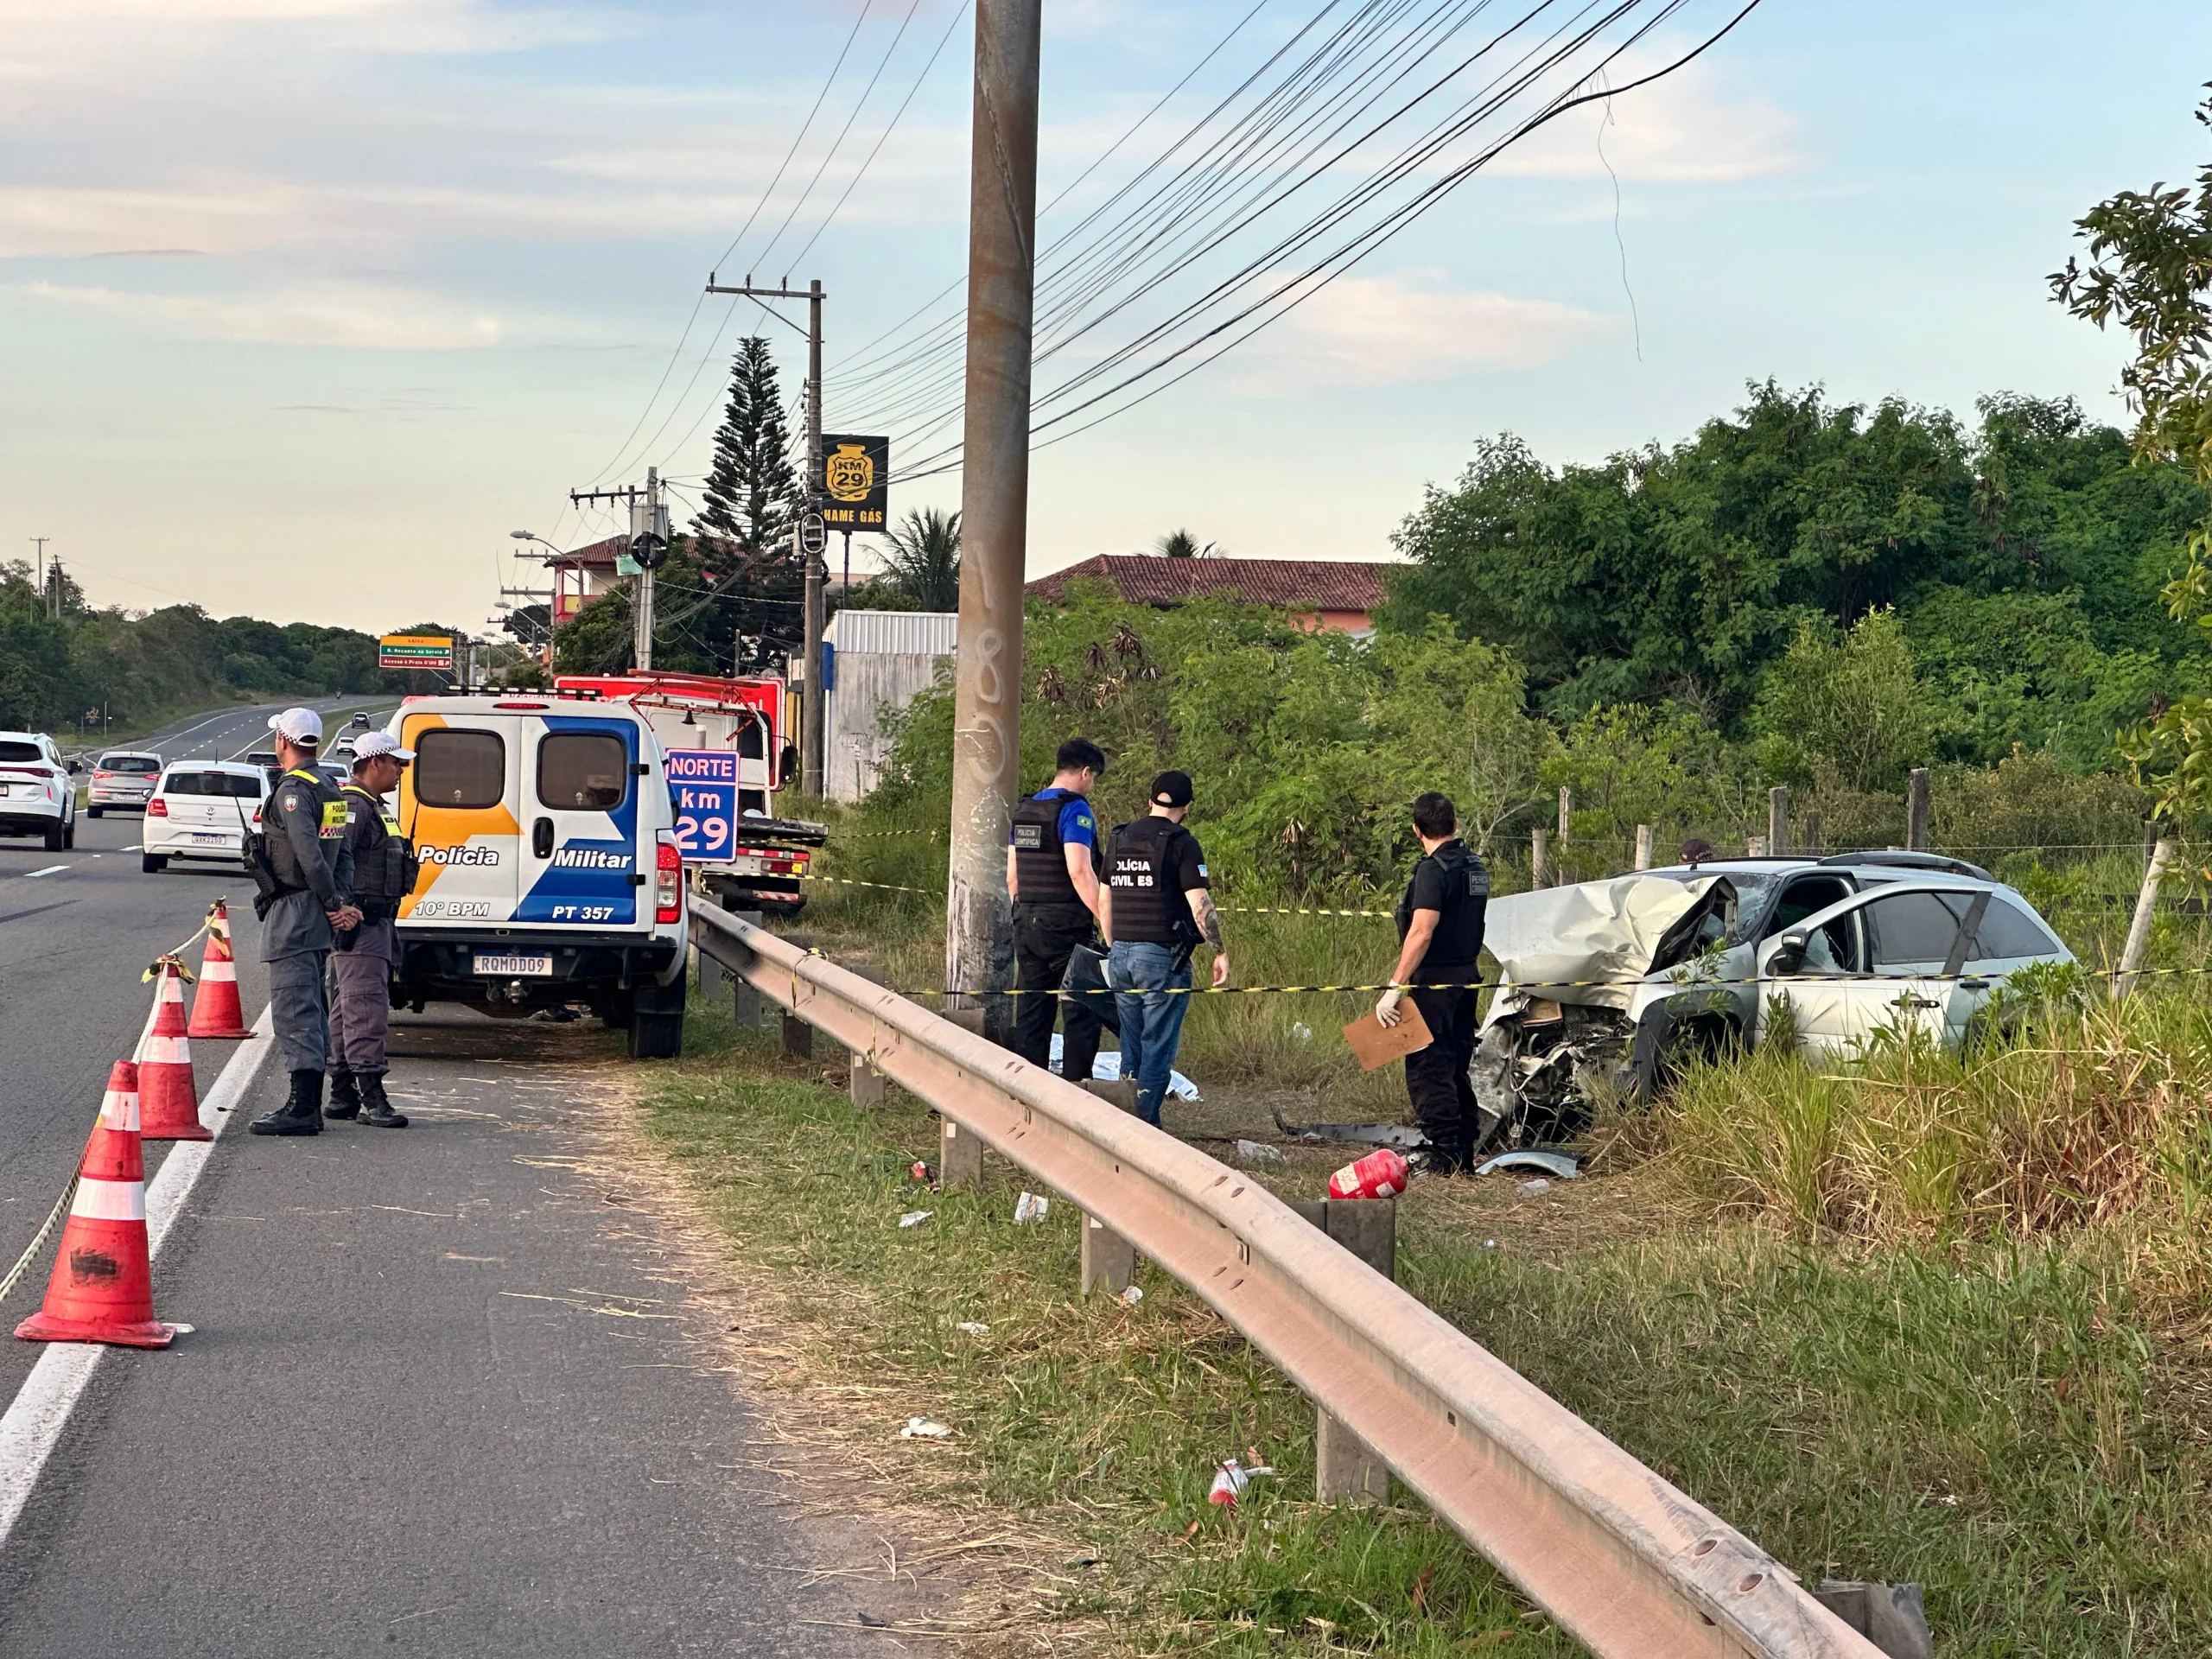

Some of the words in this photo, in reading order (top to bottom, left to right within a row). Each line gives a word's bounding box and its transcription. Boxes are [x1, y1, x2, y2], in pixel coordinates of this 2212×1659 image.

[838, 461, 861, 470] KM
[836, 472, 864, 486] 29
[823, 509, 855, 522] HAME
[860, 507, 882, 523] GÁS
[671, 757, 733, 777] NORTE
[681, 787, 721, 810] km
[676, 816, 728, 850] 29
[417, 845, 499, 866] Polícia
[554, 849, 632, 869] Militar
[1116, 858, 1151, 871] OLÍCIA
[1110, 875, 1134, 887] CIVIL
[1137, 875, 1154, 887] ES
[448, 902, 491, 917] BPM
[552, 906, 579, 919] PT
[581, 906, 614, 920] 357
